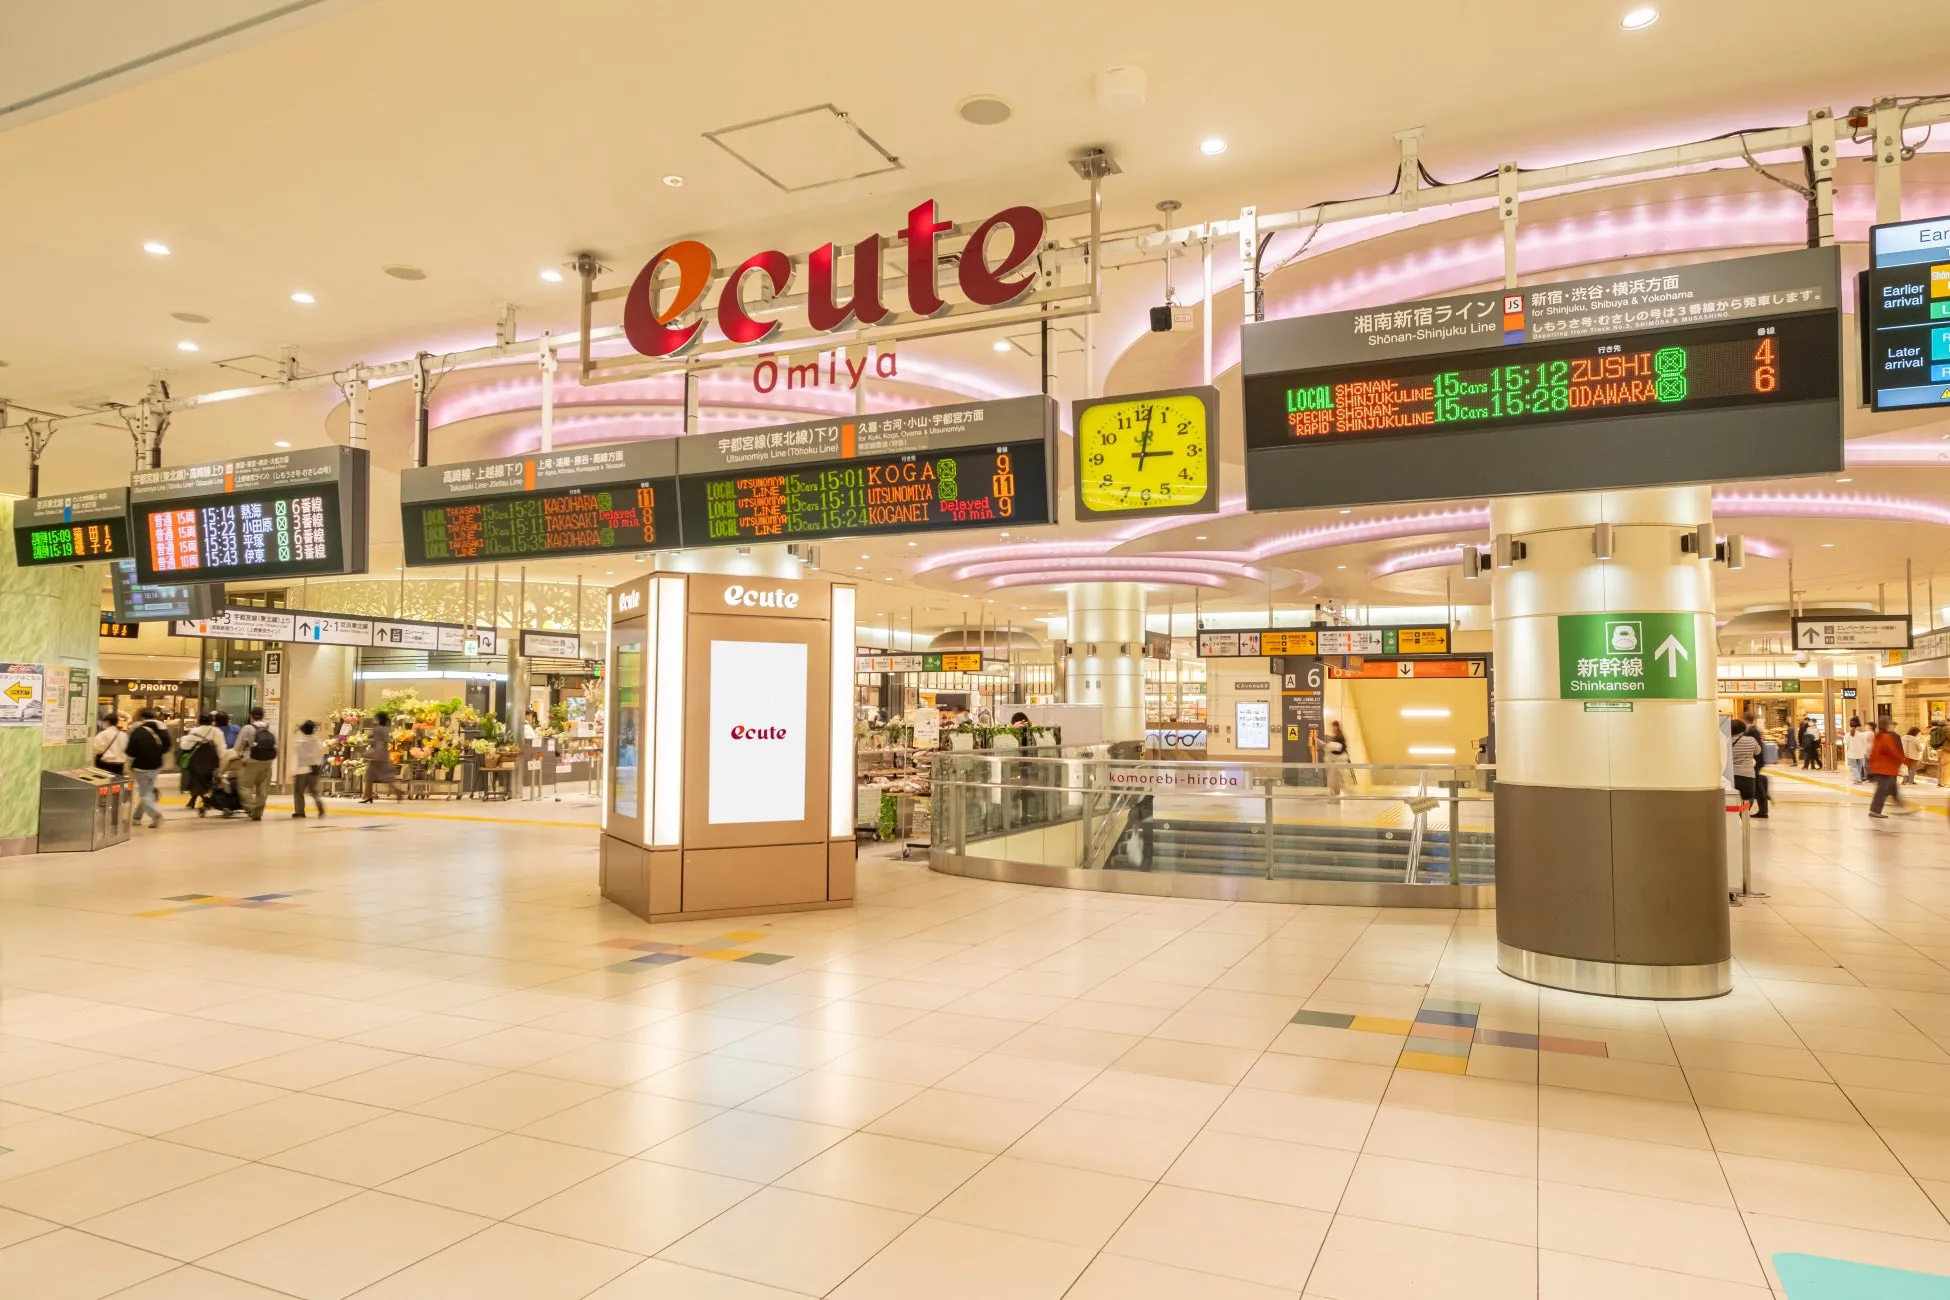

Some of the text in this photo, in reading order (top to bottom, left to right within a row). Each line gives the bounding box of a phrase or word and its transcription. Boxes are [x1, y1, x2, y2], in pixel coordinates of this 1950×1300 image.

[624, 198, 1047, 358] ecute
[1532, 275, 1679, 306] 新宿・渋谷・横浜方面
[1883, 283, 1925, 297] Earlier
[1507, 299, 1520, 310] JS
[1532, 291, 1693, 317] for Shinjuku, Shibuya & Yokohama
[1883, 295, 1924, 309] arrival
[1354, 301, 1496, 334] 湘南新宿ライン
[1368, 322, 1496, 346] Shōnan-Shinjuku Line
[1533, 331, 1568, 340] Departing
[1570, 327, 1588, 336] from
[1590, 325, 1610, 333] Track
[1598, 344, 1622, 354] 行き先
[1887, 346, 1921, 359] Later
[1884, 357, 1924, 370] arrival
[753, 351, 897, 394] Ōmiya
[1287, 385, 1334, 412] LOCAL
[1490, 360, 1568, 392] 15:12
[1571, 352, 1653, 383] ZUSHI
[1754, 338, 1774, 365] 4
[1754, 366, 1775, 393] 6
[1491, 385, 1569, 417] 15:28
[1568, 379, 1657, 408] ODAWARA
[858, 409, 983, 434] 久喜・古河・小山・宇都宮方面
[1118, 417, 1132, 430] 11
[1160, 410, 1168, 424] 1
[1288, 409, 1335, 425] SPECIAL
[929, 425, 965, 435] Utsunomiya
[1177, 422, 1189, 435] 2
[1296, 422, 1329, 436] RAPID
[1101, 433, 1117, 445] 10
[726, 452, 768, 463] Utsunomiya
[771, 450, 787, 458] Line
[819, 443, 838, 453] Line)
[1186, 444, 1198, 457] 3
[996, 454, 1010, 475] 9
[1093, 453, 1104, 466] 9
[443, 462, 523, 484] 高崎線・上越線下り
[819, 469, 864, 491] 15:01
[1102, 474, 1113, 487] 8
[1178, 467, 1189, 480] 4
[706, 480, 737, 500] LOCAL
[737, 476, 785, 489] UTSUNOMIYA
[1160, 483, 1171, 495] 5
[708, 475, 1012, 519] LOCAL UTSUNOMIYA LINE 15:11 UTSUNOMIYA 11
[753, 486, 780, 497] LINE
[1121, 486, 1131, 499] 7
[1140, 488, 1151, 501] 6
[202, 505, 235, 522] 15:14
[241, 504, 262, 520] 熱海
[292, 497, 323, 515] 6番線
[446, 505, 481, 516] TAKASAKI
[508, 500, 544, 519] 15:21
[544, 495, 597, 514] KAGOHARA
[639, 490, 652, 506] 11
[940, 496, 989, 512] Delayed
[999, 497, 1012, 517] 9
[600, 507, 636, 519] Delayed
[643, 508, 652, 524] 8
[740, 514, 787, 527] UTSUNOMIYA
[822, 508, 868, 529] 15:24
[869, 502, 929, 525] KOGANEI
[953, 511, 965, 522] 10
[203, 522, 236, 537] 15:22
[242, 518, 273, 534] 小田原
[293, 513, 324, 531] 3番線
[509, 518, 545, 536] 15:11
[545, 512, 598, 531] TAKASAKI
[609, 519, 619, 528] 10
[709, 518, 740, 538] LOCAL
[48, 525, 110, 544] 15:09 1
[755, 525, 782, 536] LINE
[204, 537, 237, 552] 15:33
[243, 534, 265, 548] 平塚
[294, 529, 326, 546] 6番線
[510, 534, 547, 553] 15:35
[546, 530, 600, 548] KAGOHARA
[644, 526, 654, 543] 8
[49, 543, 73, 557] 15:19
[104, 539, 112, 553] 2
[205, 551, 238, 567] 15:43
[244, 549, 266, 564] 伊東
[296, 544, 326, 560] 3番線
[619, 589, 640, 612] ecute
[724, 585, 799, 609] ecute
[1472, 662, 1480, 676] 7
[1577, 657, 1644, 678] 新幹線
[1287, 675, 1295, 687] A
[1307, 668, 1320, 688] 6
[1571, 680, 1645, 692] Shinkansen
[140, 683, 178, 692] PRONTO
[731, 725, 787, 740] ecute
[1289, 727, 1298, 735] A
[1109, 771, 1237, 786] komorebi-hiroba
